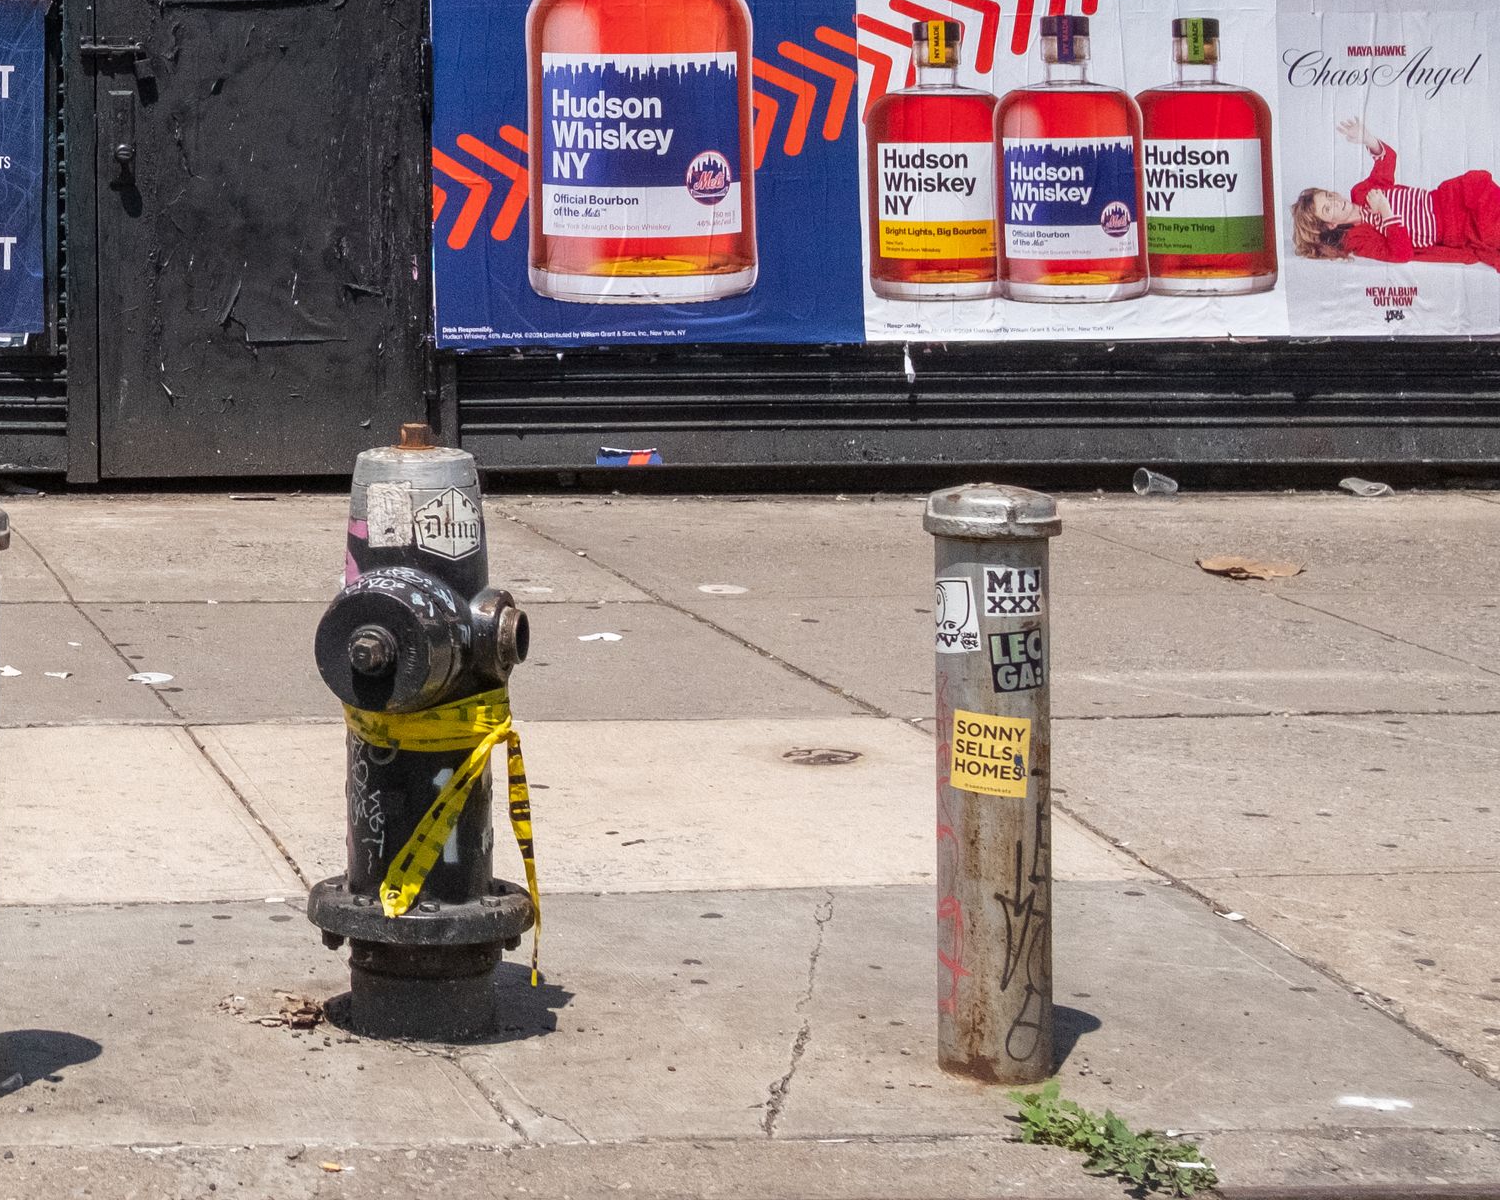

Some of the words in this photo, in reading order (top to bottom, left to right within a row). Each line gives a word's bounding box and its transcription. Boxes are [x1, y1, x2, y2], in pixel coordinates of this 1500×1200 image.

[1347, 45, 1373, 57] MAYA
[1374, 45, 1407, 57] HAWKE
[1282, 48, 1369, 88] Chaos
[1371, 46, 1482, 100] Angel
[552, 88, 662, 119] Hudson
[552, 120, 674, 156] Whiskey
[552, 151, 590, 180] NY
[884, 148, 969, 169] Hudson
[1144, 145, 1230, 166] Hudson
[1010, 161, 1084, 181] Hudson
[1145, 168, 1238, 193] Whiskey
[884, 171, 977, 197] Whiskey
[1010, 182, 1093, 206] Whiskey
[553, 193, 587, 206] Official
[589, 194, 639, 206] Bourbon
[884, 195, 913, 215] NY
[1146, 191, 1176, 212] NY
[553, 206, 563, 217] of
[563, 207, 580, 217] the
[1011, 202, 1037, 222] NY
[581, 223, 608, 232] Straight
[609, 223, 640, 231] Bourbon
[641, 223, 671, 232] Whiskey
[885, 227, 906, 237] Bright
[907, 227, 935, 237] Lights,
[937, 227, 952, 237] Big
[952, 227, 987, 235] Bourbon
[1012, 230, 1035, 238] Official
[1036, 231, 1070, 239] Bourbon
[1158, 223, 1172, 232] The
[1173, 224, 1189, 233] Rye
[1190, 224, 1216, 233] Thing
[1365, 286, 1386, 297] NEW
[1388, 286, 1418, 297] ALBUM
[1373, 296, 1391, 307] OUT
[1392, 296, 1413, 307] NOW
[458, 326, 493, 334] Responsibly.
[987, 594, 1041, 614] XXX
[956, 720, 1026, 743] SONNY
[955, 738, 1013, 761] SELLS
[954, 757, 1023, 781] HOMES
